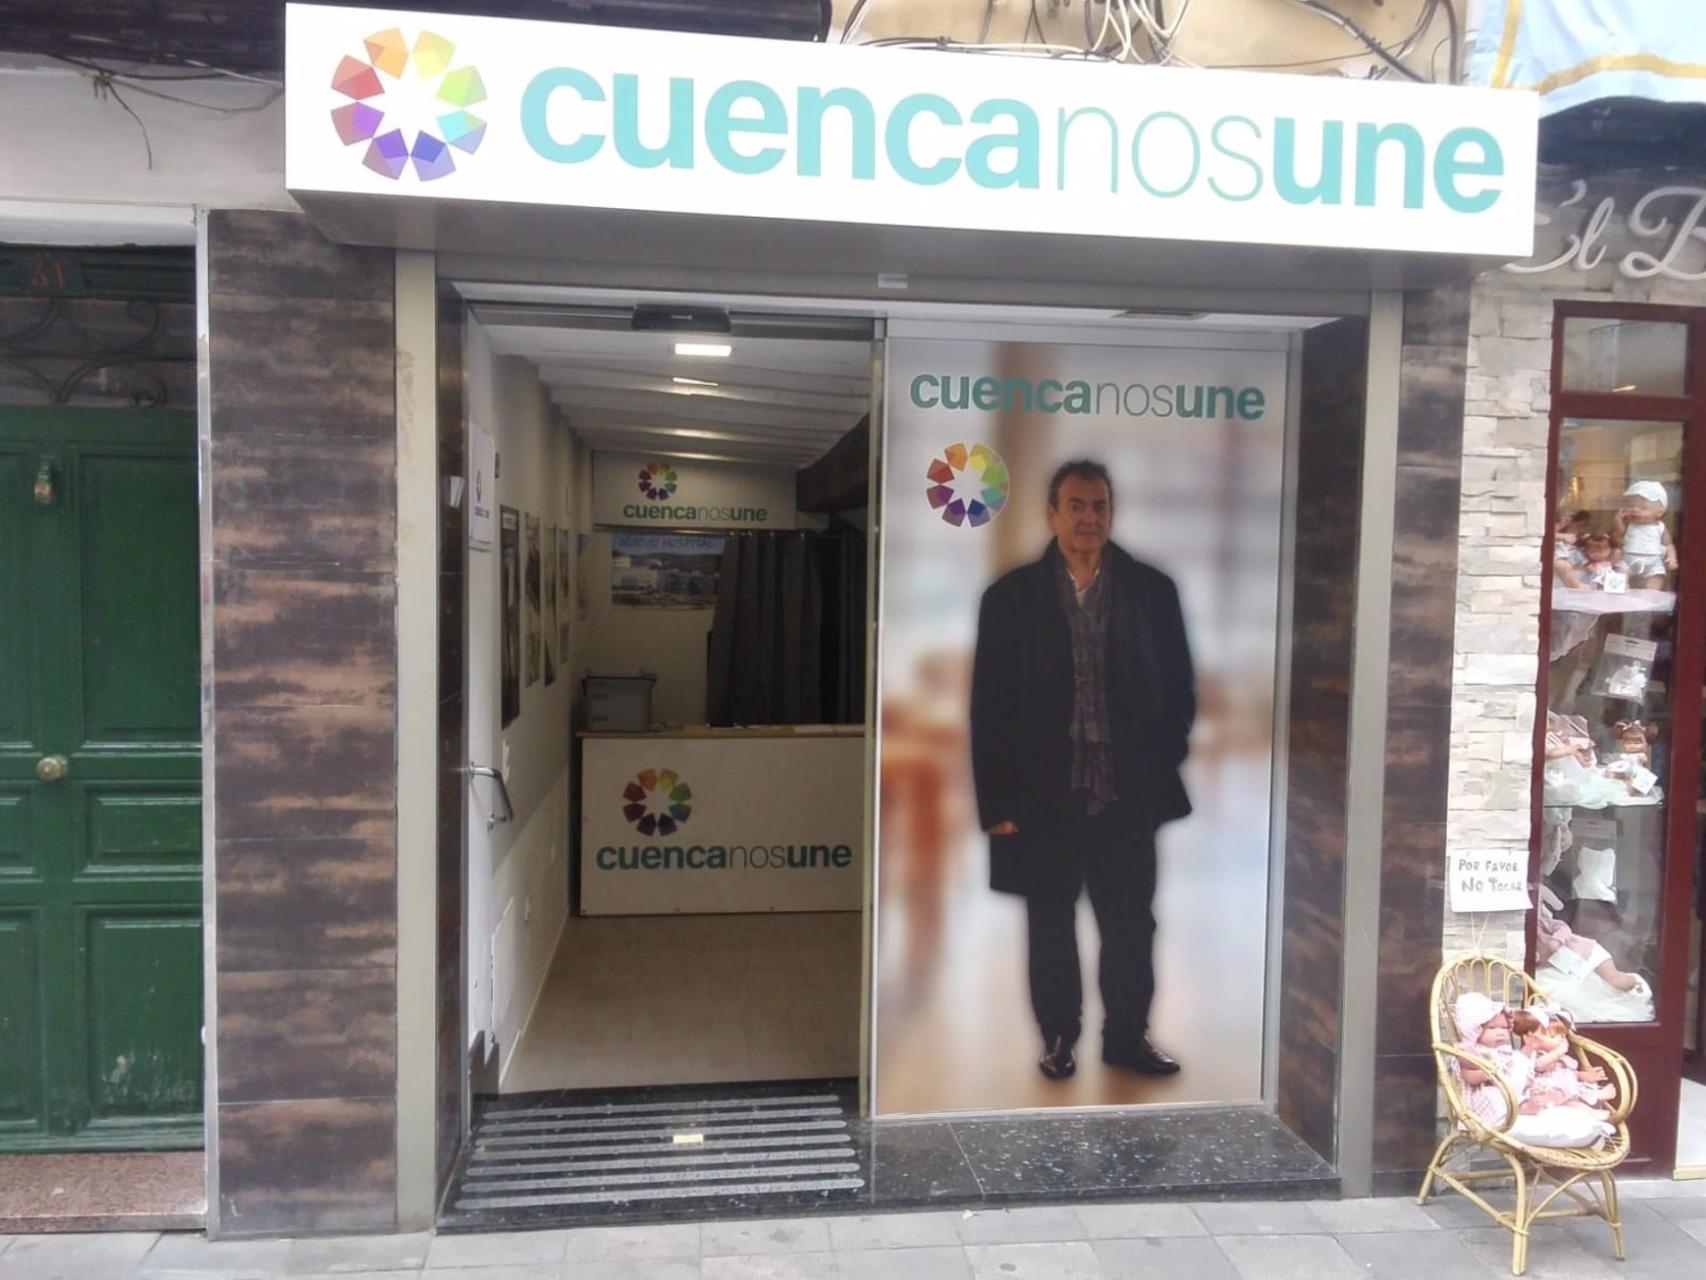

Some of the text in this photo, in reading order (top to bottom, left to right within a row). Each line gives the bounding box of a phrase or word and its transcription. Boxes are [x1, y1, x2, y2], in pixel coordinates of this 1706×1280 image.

[520, 66, 1504, 214] cuencanosune
[910, 373, 1266, 421] cuencanosune
[623, 503, 768, 522] cuencanosune
[596, 844, 852, 870] cuencanosune
[1458, 859, 1518, 872] POR FAVOR
[1461, 877, 1483, 893] NO
